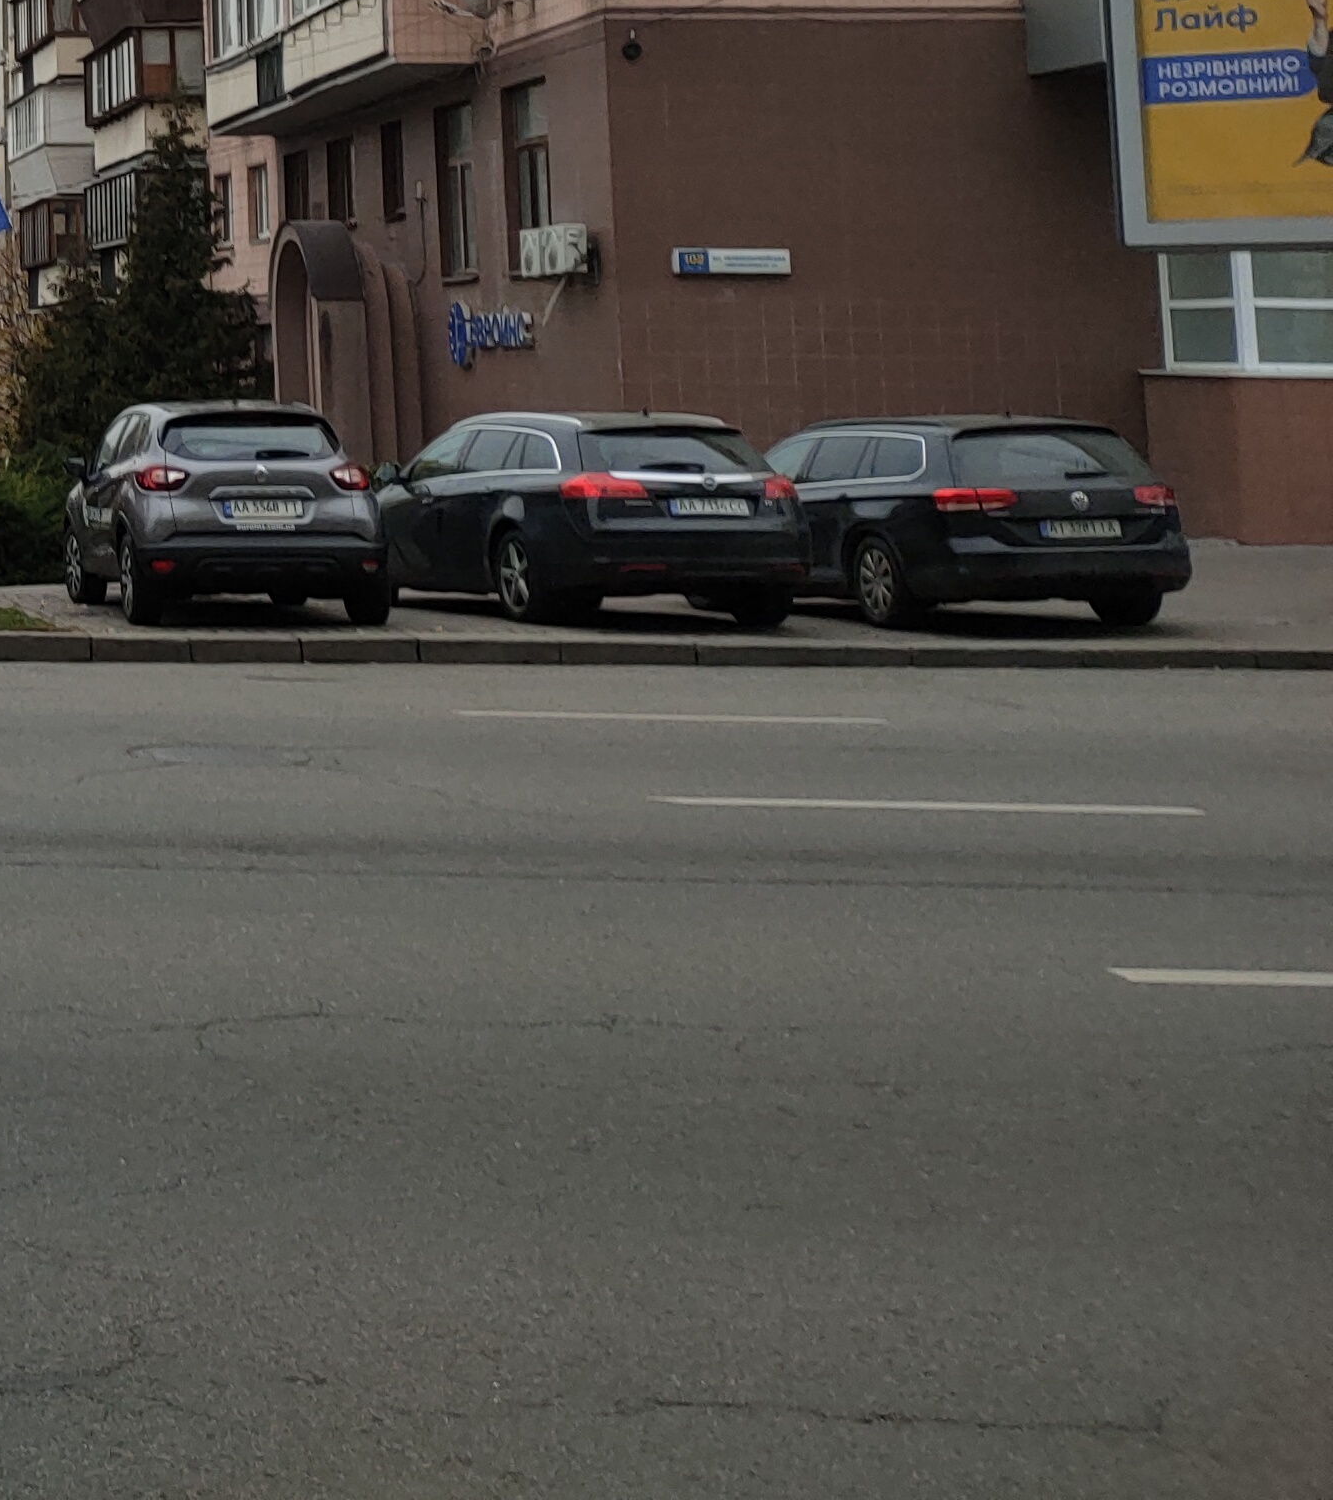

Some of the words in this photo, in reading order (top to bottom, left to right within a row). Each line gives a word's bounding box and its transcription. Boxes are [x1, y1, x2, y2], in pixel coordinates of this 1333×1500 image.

[1154, 3, 1258, 33] Лайф
[1157, 55, 1300, 80] НЕЗРІВНЯННО
[1159, 73, 1299, 98] РОЗМОВНИЙ!
